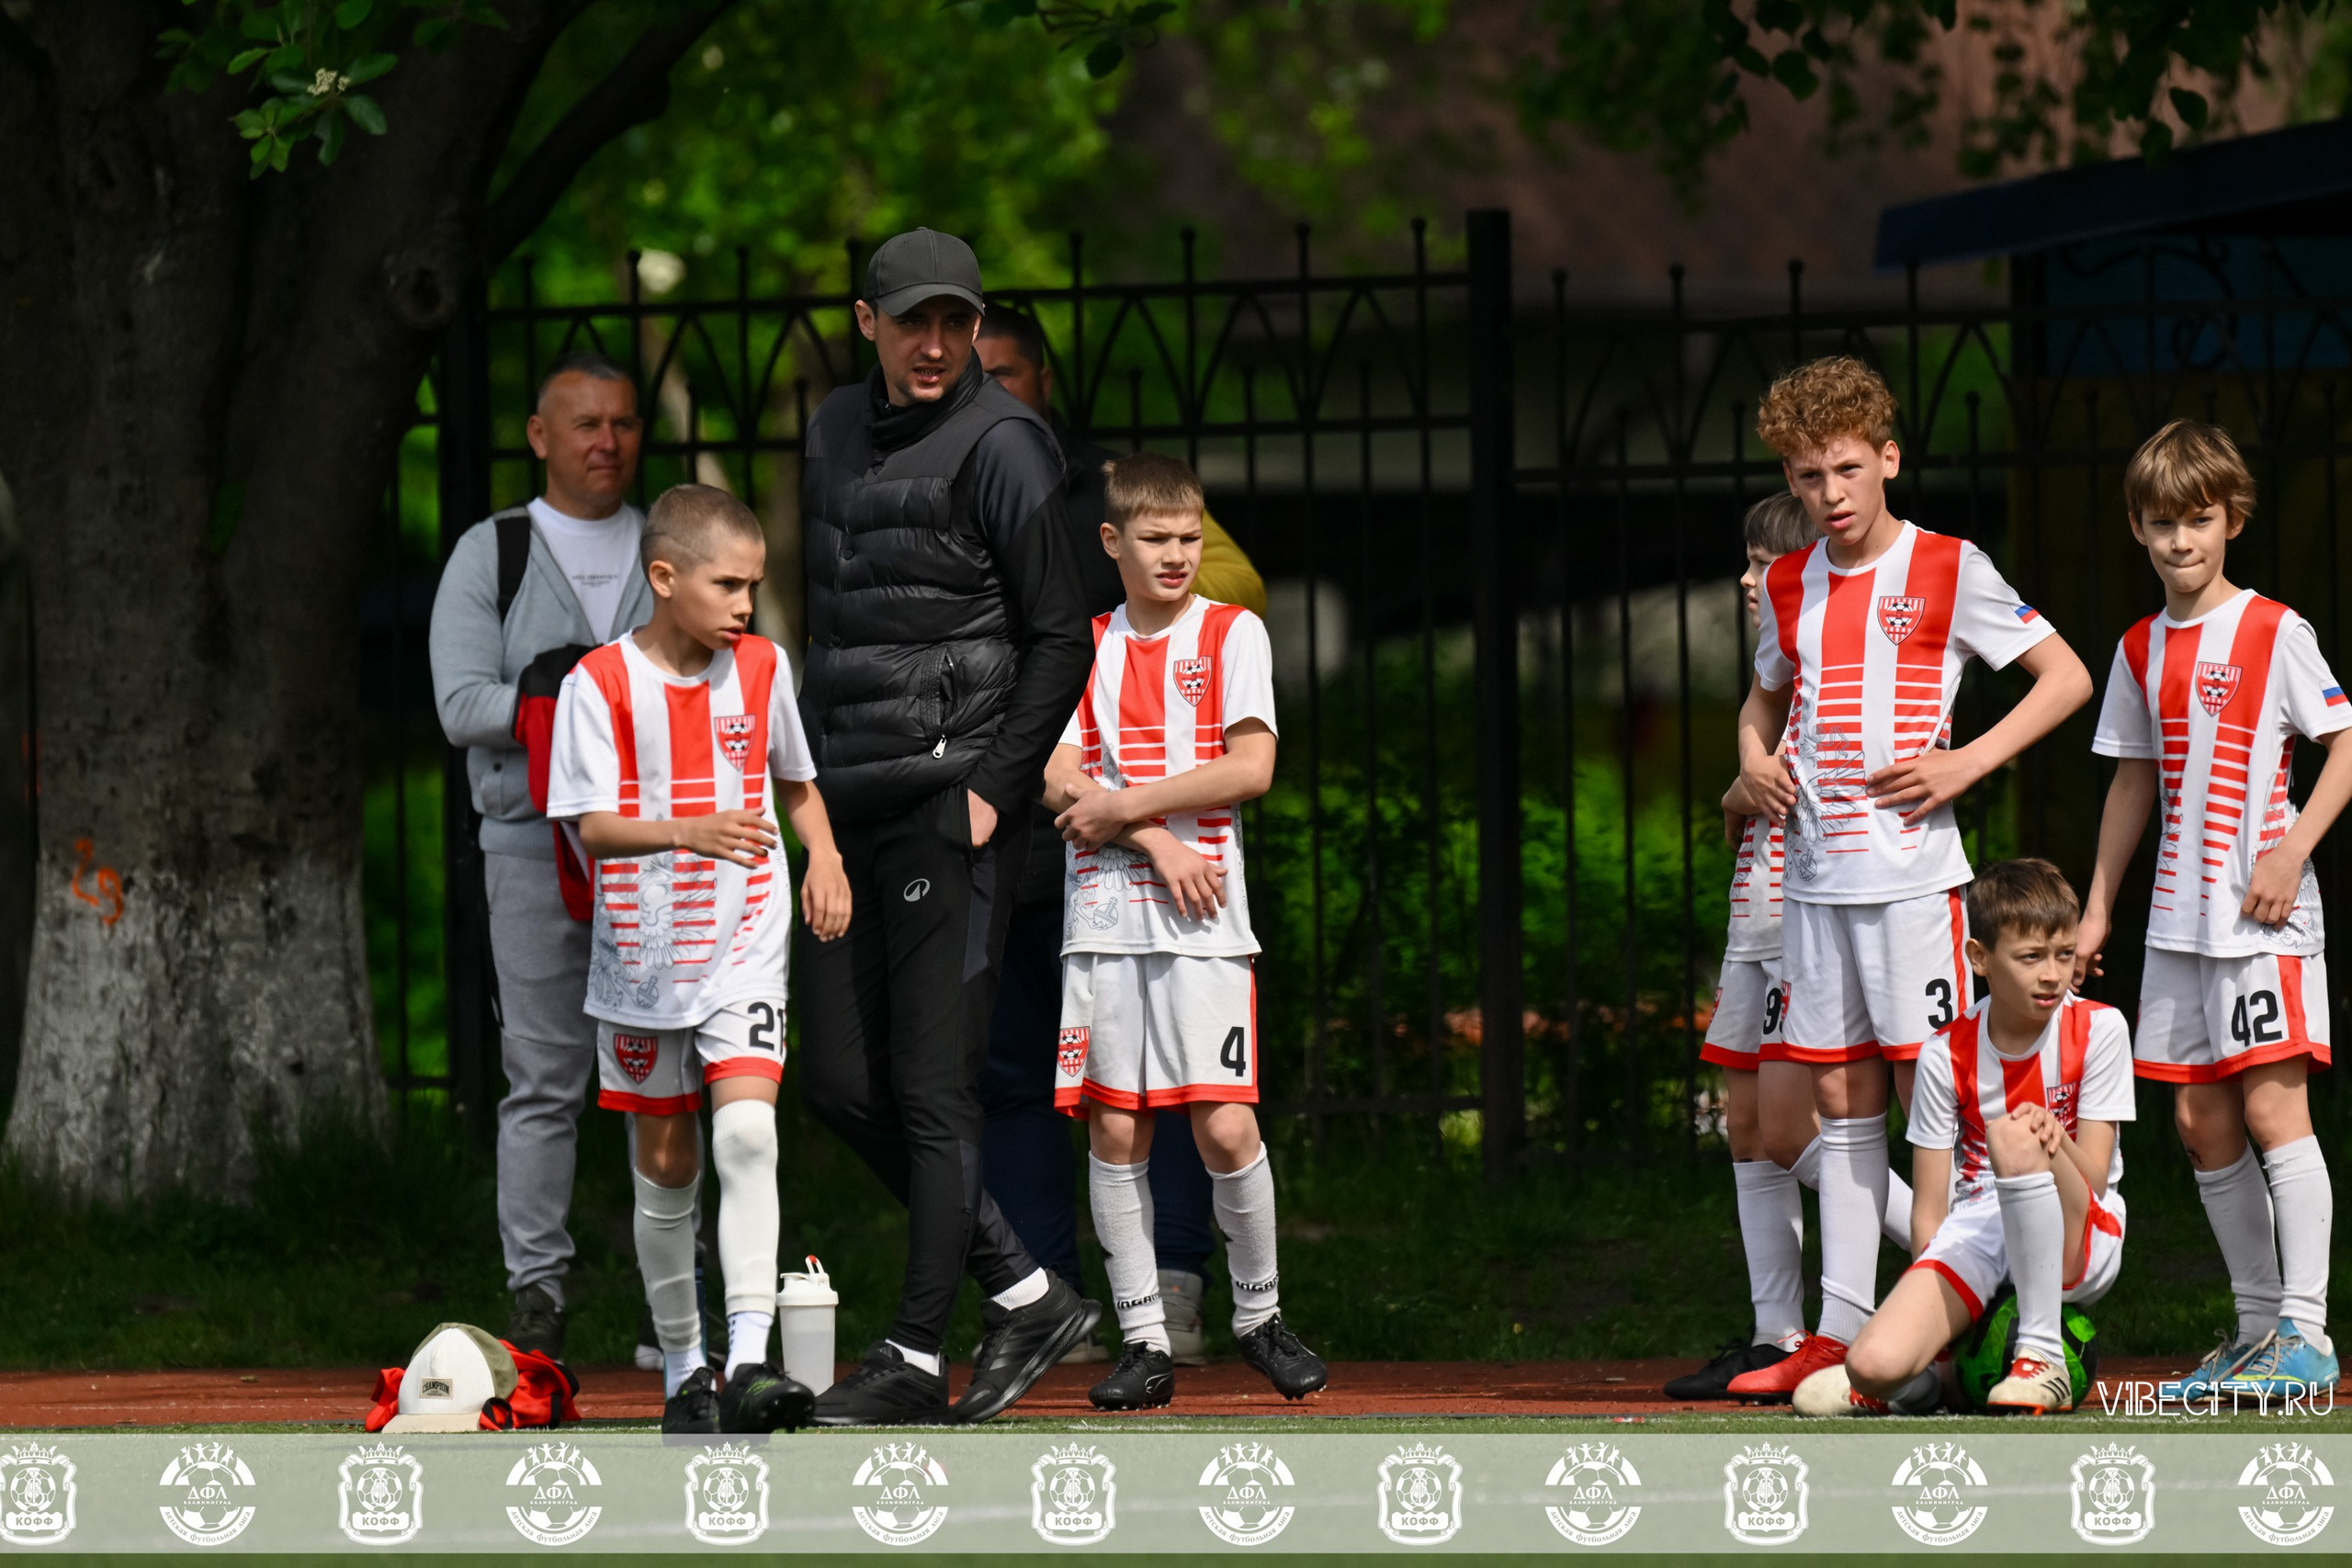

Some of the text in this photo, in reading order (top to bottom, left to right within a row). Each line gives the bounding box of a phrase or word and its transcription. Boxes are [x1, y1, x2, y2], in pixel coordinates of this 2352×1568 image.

[1763, 987, 1783, 1035] 9
[1925, 978, 1953, 1030] 3
[2231, 989, 2282, 1046] 42
[1220, 1026, 1247, 1077] 4
[423, 1381, 449, 1394] CHAMPION
